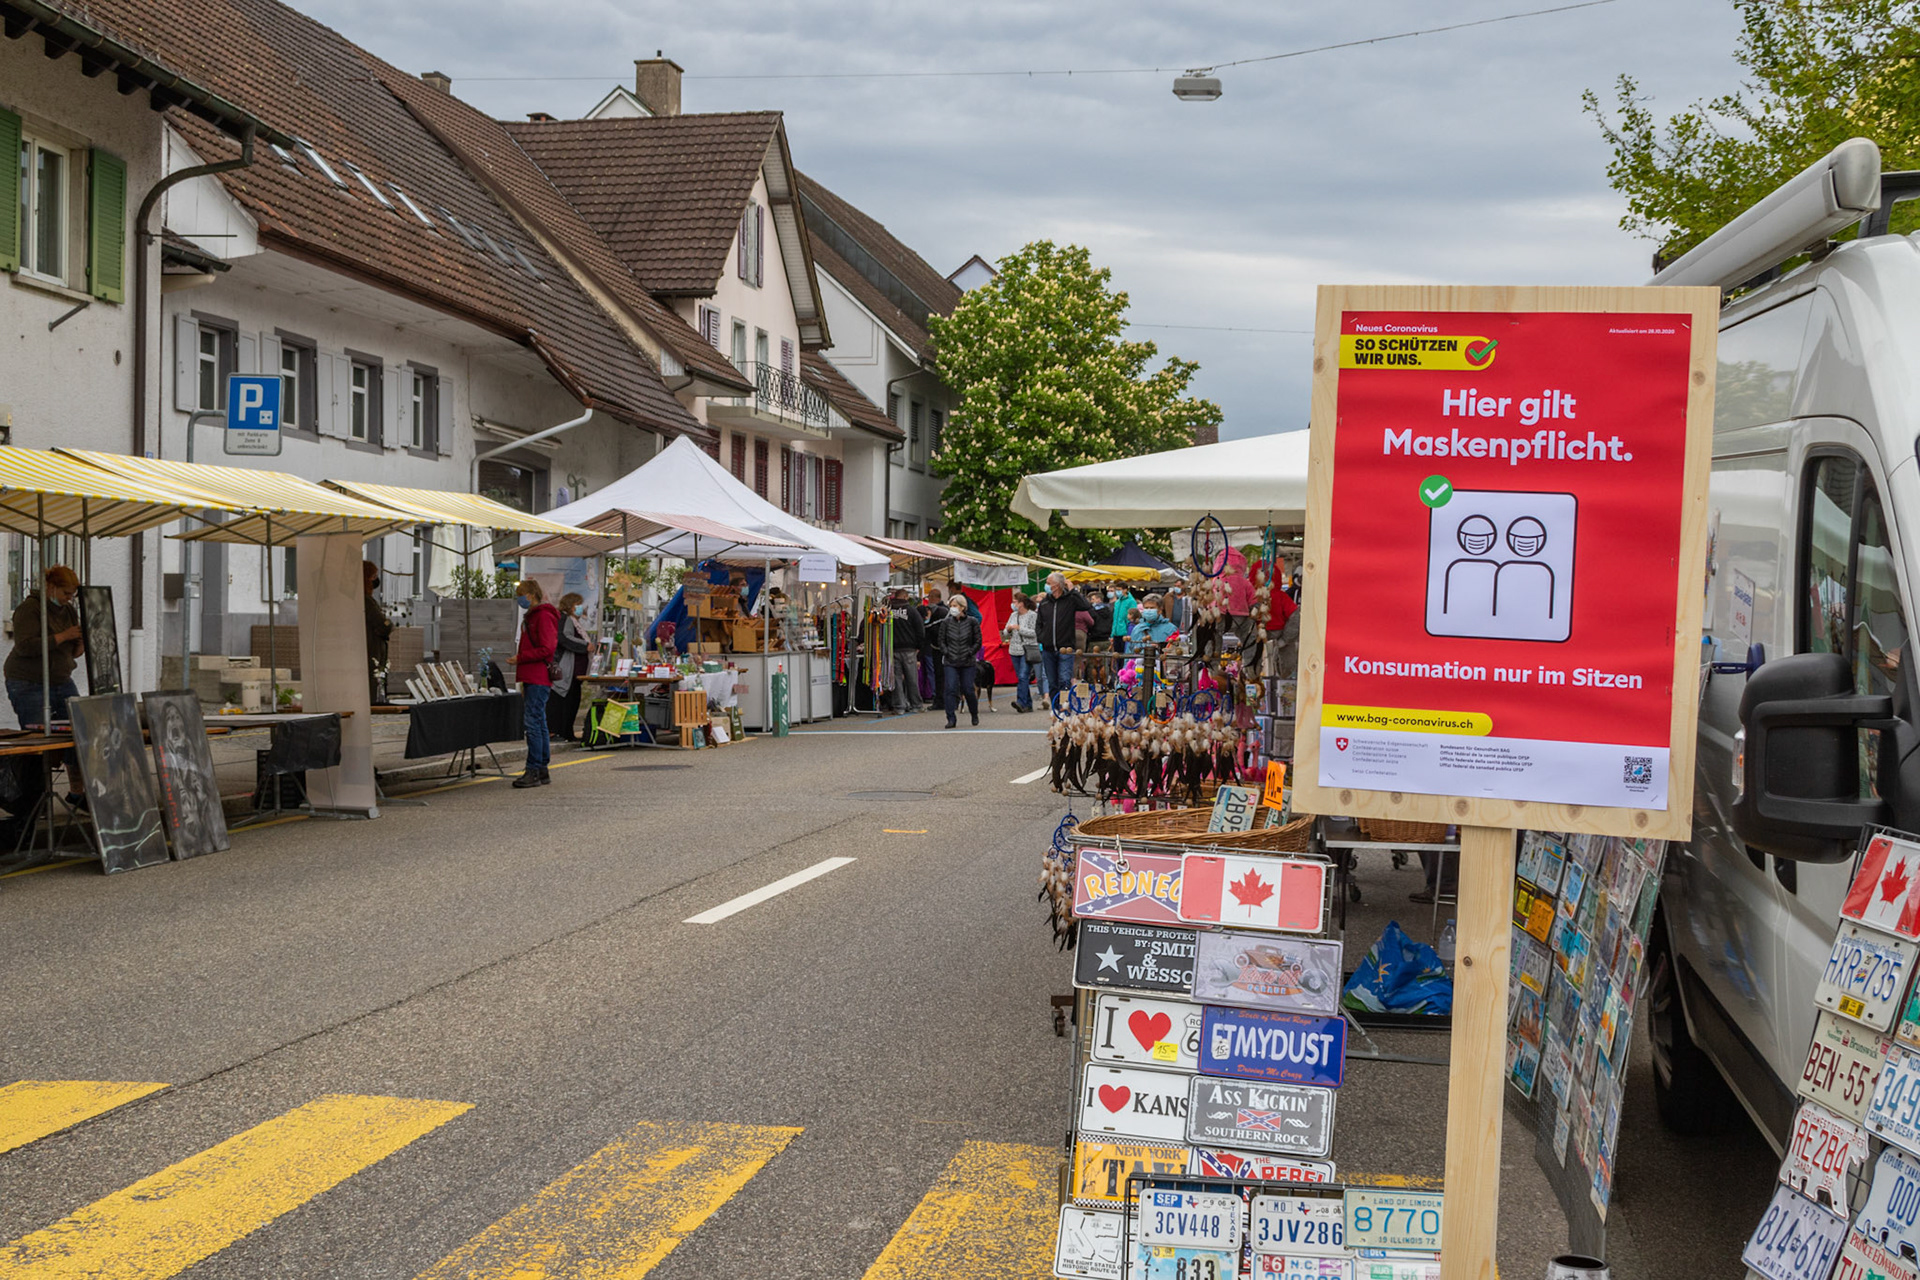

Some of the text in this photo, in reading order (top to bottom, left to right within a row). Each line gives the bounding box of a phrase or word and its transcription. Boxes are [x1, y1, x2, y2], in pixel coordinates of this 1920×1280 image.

[1356, 324, 1438, 333] Neues Coronavirus
[1355, 337, 1458, 351] SO SCHÜTZEN
[1355, 353, 1422, 365] WIR UNS.
[238, 383, 263, 421] P
[1442, 388, 1576, 425] Hier gilt
[1383, 428, 1633, 466] Maskenpflicht.
[1344, 656, 1643, 690] Konsumation nur im Sitzen
[1336, 712, 1474, 730] www.bag-coronavirus.ch
[1087, 925, 1109, 933] THIS
[1112, 926, 1154, 937] VEHICLE
[1143, 953, 1157, 968] &
[1862, 954, 1902, 1001] 735
[1101, 1006, 1119, 1049] I
[1237, 1064, 1264, 1075] Driving
[1087, 1087, 1189, 1118] I KANS
[1205, 1126, 1309, 1146] SOUTHERN ROCK
[1115, 1146, 1181, 1160] NEW YORK
[1792, 1118, 1849, 1179] RE284
[1156, 1194, 1178, 1204] SEP
[1155, 1211, 1220, 1238] 3CV448
[1354, 1207, 1439, 1235] 8770
[1800, 1204, 1821, 1225] 1972
[1258, 1218, 1342, 1245] 3JV286
[1757, 1205, 1800, 1259] 814
[1272, 1257, 1282, 1271] 6
